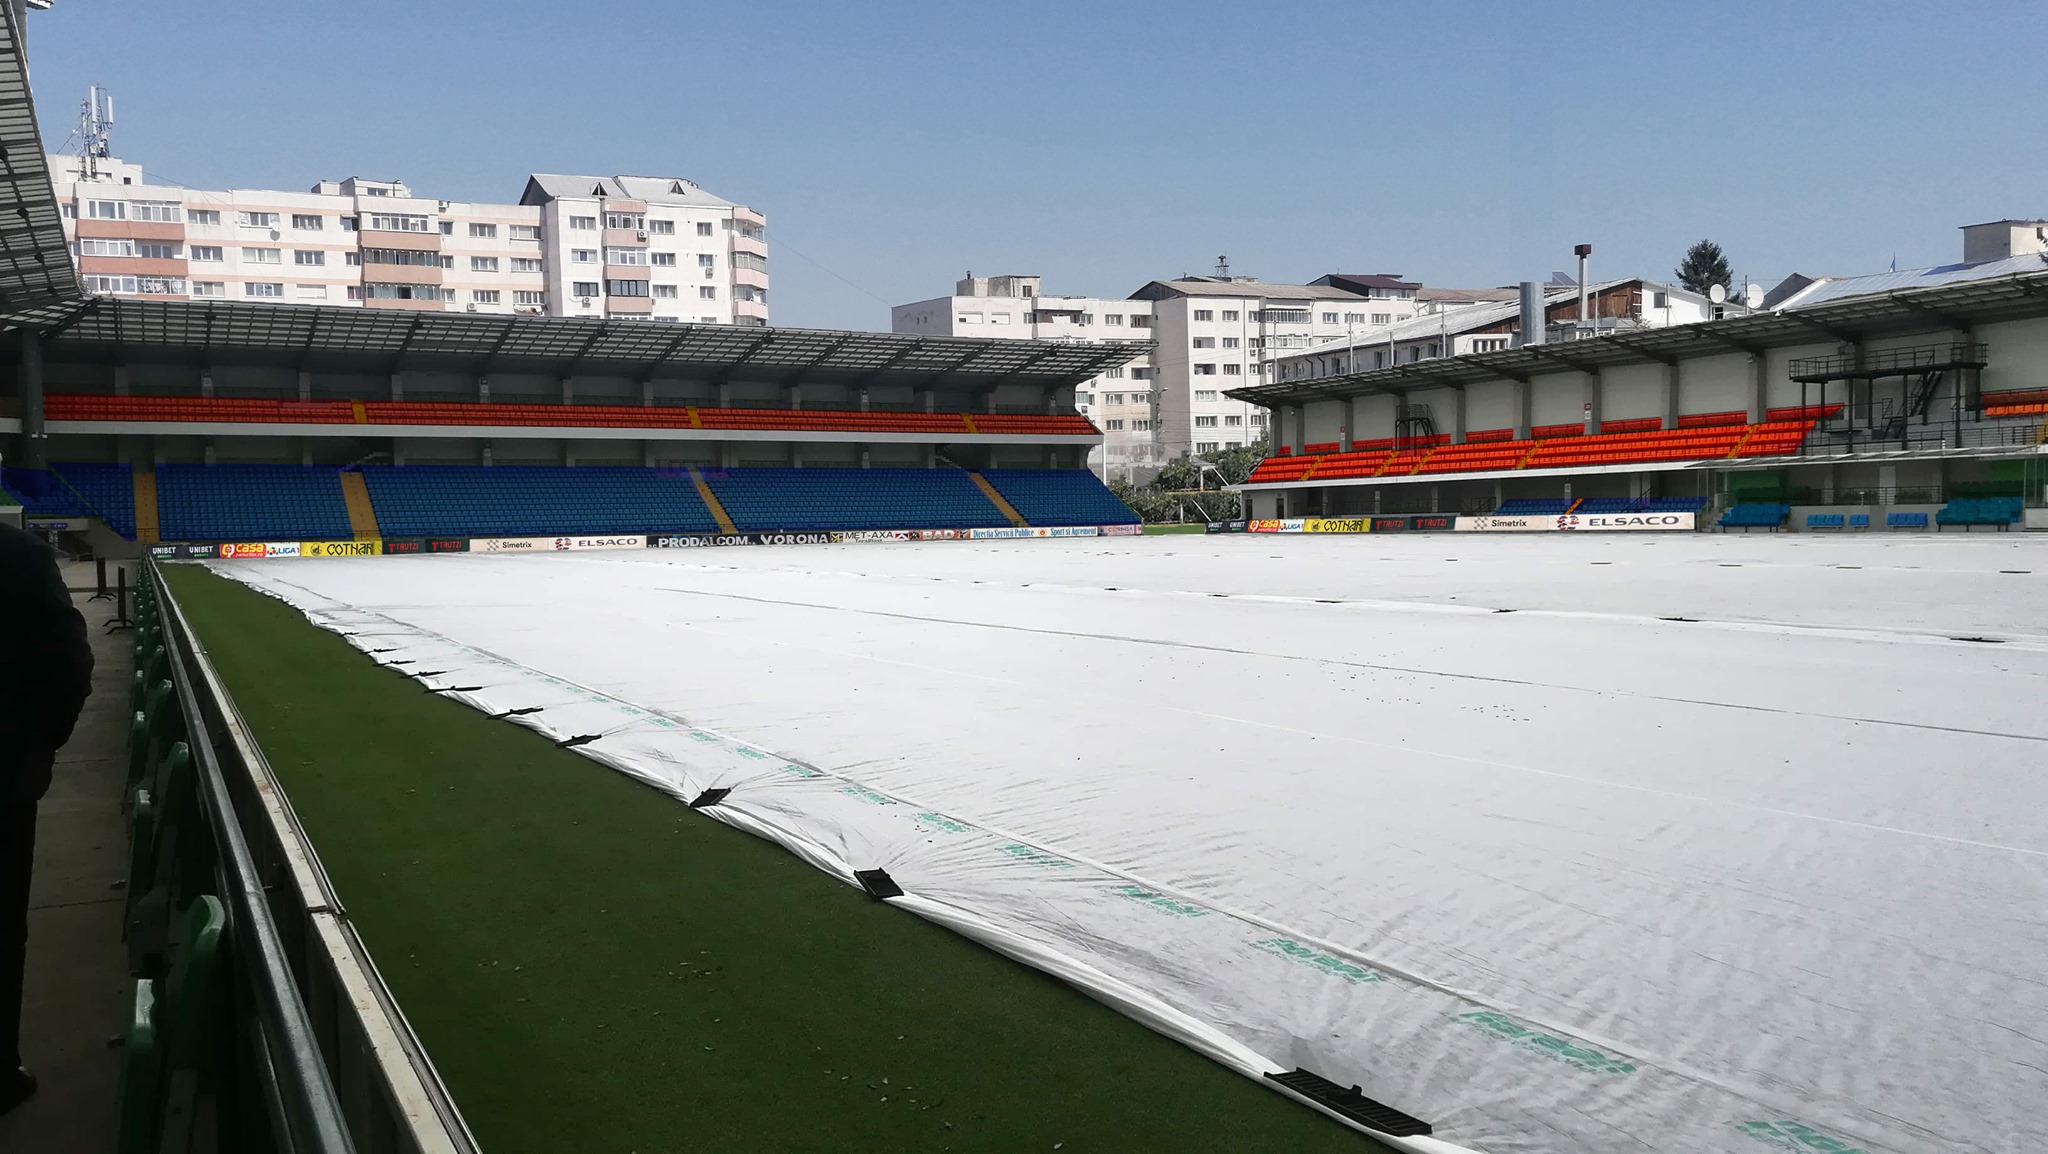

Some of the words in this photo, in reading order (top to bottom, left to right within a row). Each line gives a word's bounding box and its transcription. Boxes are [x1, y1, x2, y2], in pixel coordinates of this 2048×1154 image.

[1259, 519, 1279, 528] casa
[1424, 518, 1448, 527] TRUTZI
[1491, 519, 1527, 527] Simetrix
[1588, 516, 1679, 526] ELSACO
[844, 531, 894, 540] MET-AXA
[1015, 528, 1034, 536] Publice
[1050, 527, 1065, 538] Sport
[1071, 527, 1097, 537] Agrement
[578, 538, 638, 547] ELSACO
[658, 536, 748, 548] PRODALCOM
[760, 533, 829, 545] VORONA
[188, 545, 213, 554] UNIBET
[235, 543, 264, 553] casa
[395, 542, 419, 551] TRUTZI
[439, 541, 463, 549] TRUTZI
[502, 541, 532, 549] Simetrix
[152, 546, 177, 555] UNIBET
